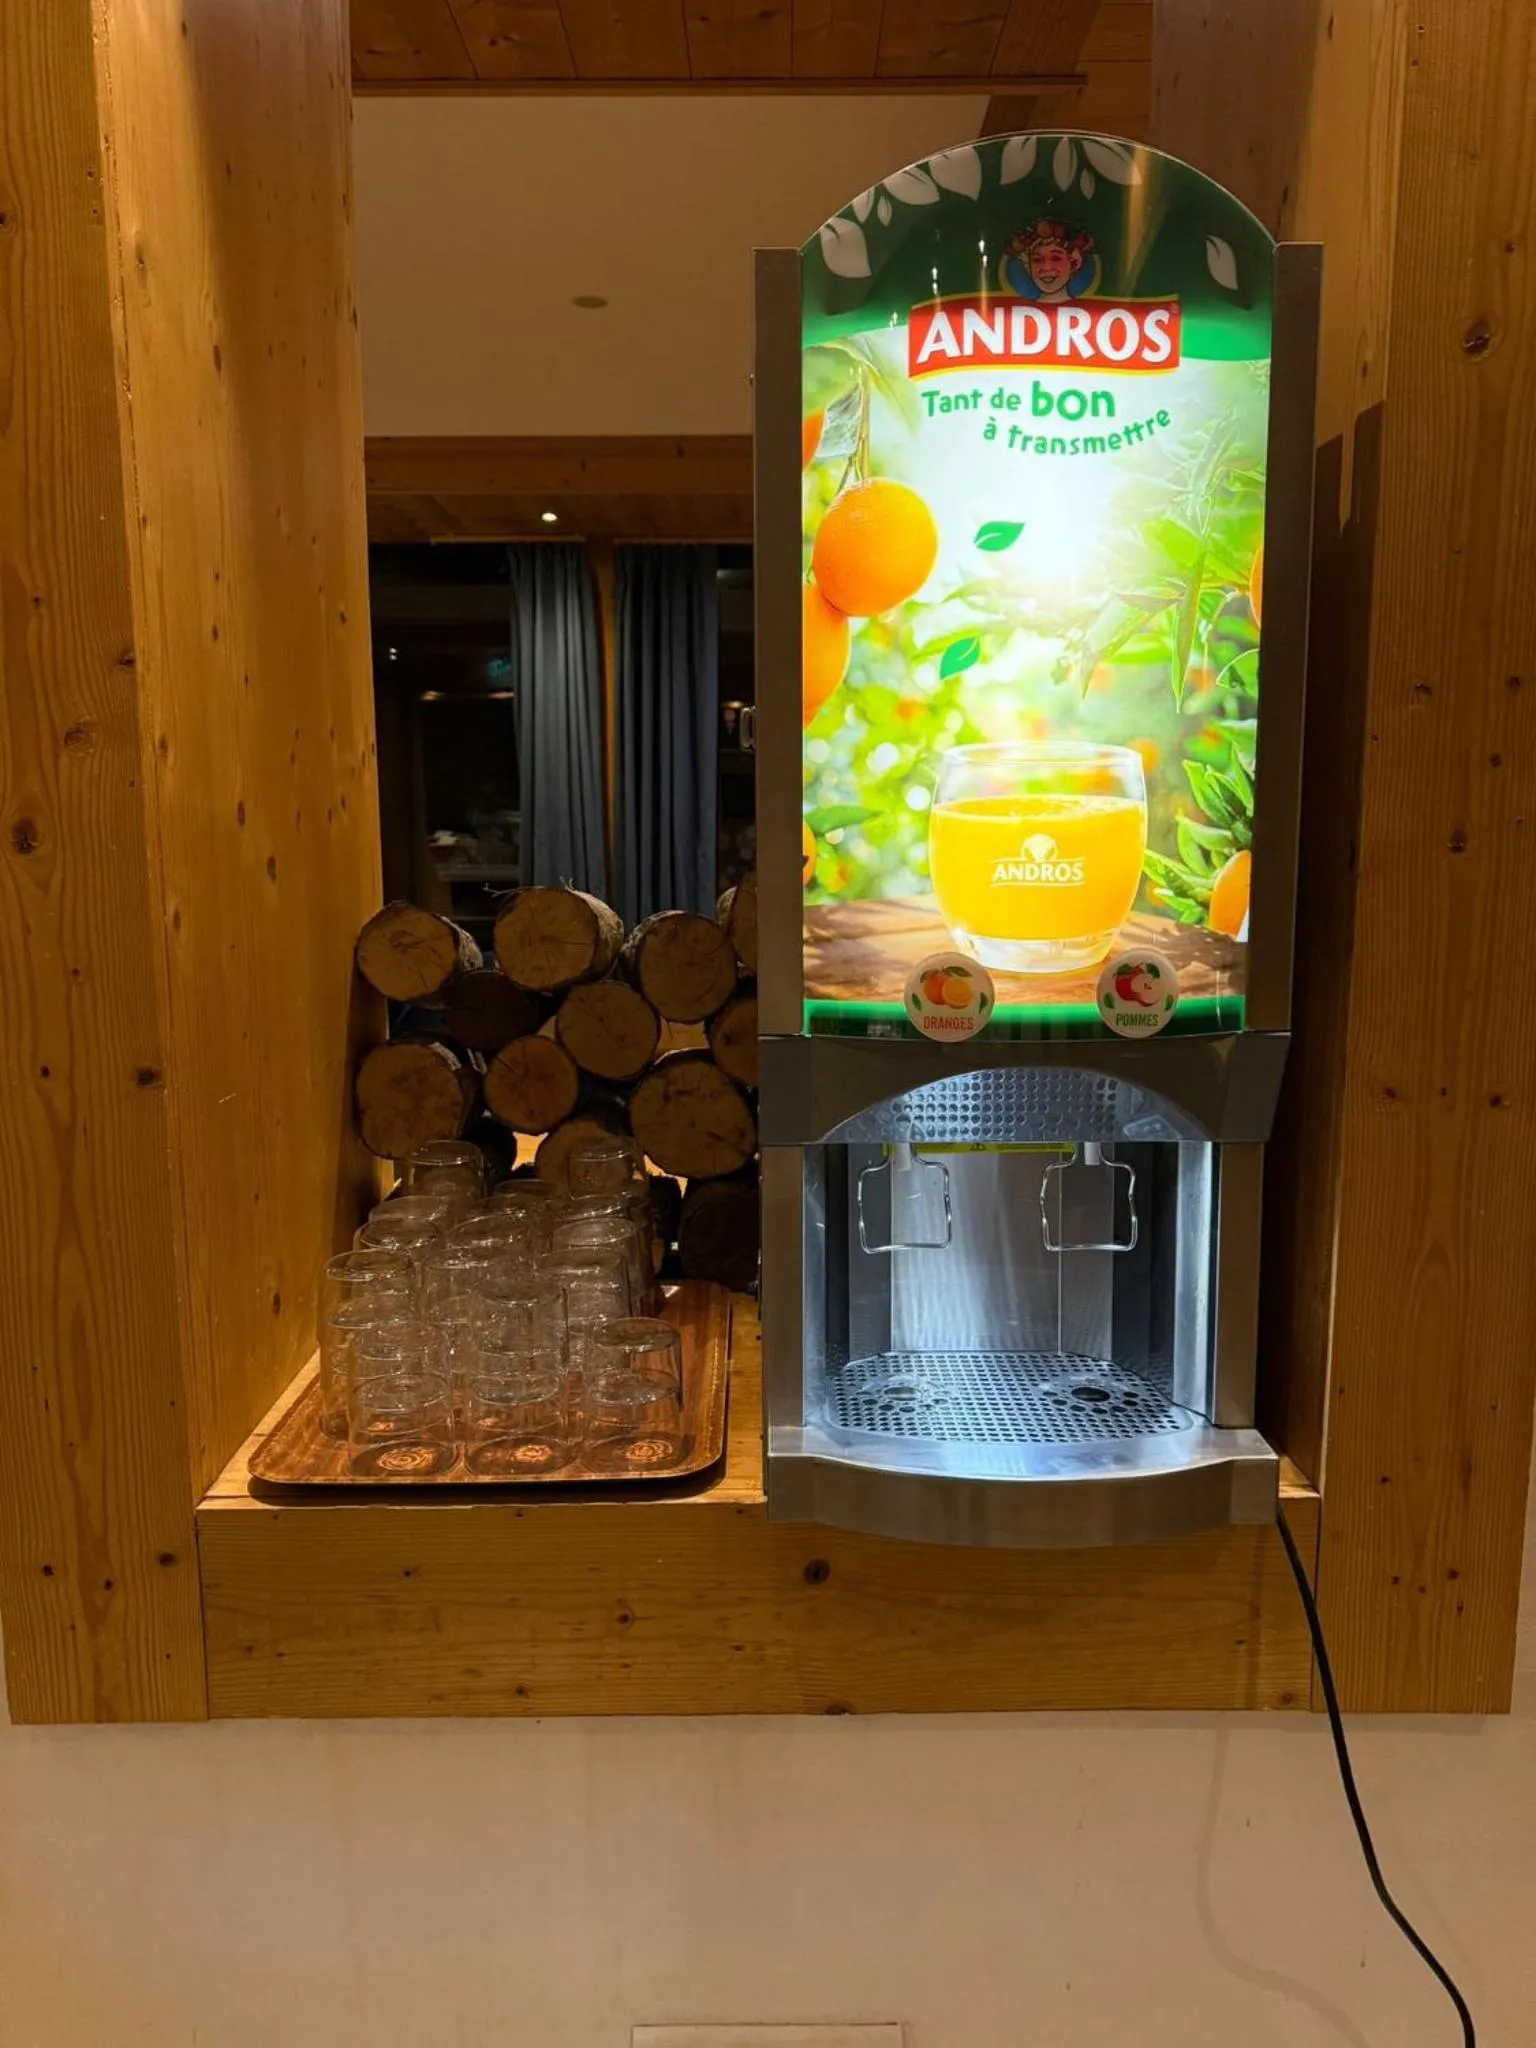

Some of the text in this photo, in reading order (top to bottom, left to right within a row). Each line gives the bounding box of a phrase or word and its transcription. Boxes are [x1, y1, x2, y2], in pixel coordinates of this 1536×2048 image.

[916, 305, 1173, 364] ANDROS
[920, 380, 1116, 421] Tant de bon
[983, 408, 1171, 456] à transmettre
[993, 861, 1085, 882] ANDROS
[923, 1015, 974, 1031] ORANGES
[1116, 1013, 1159, 1027] POMMES
